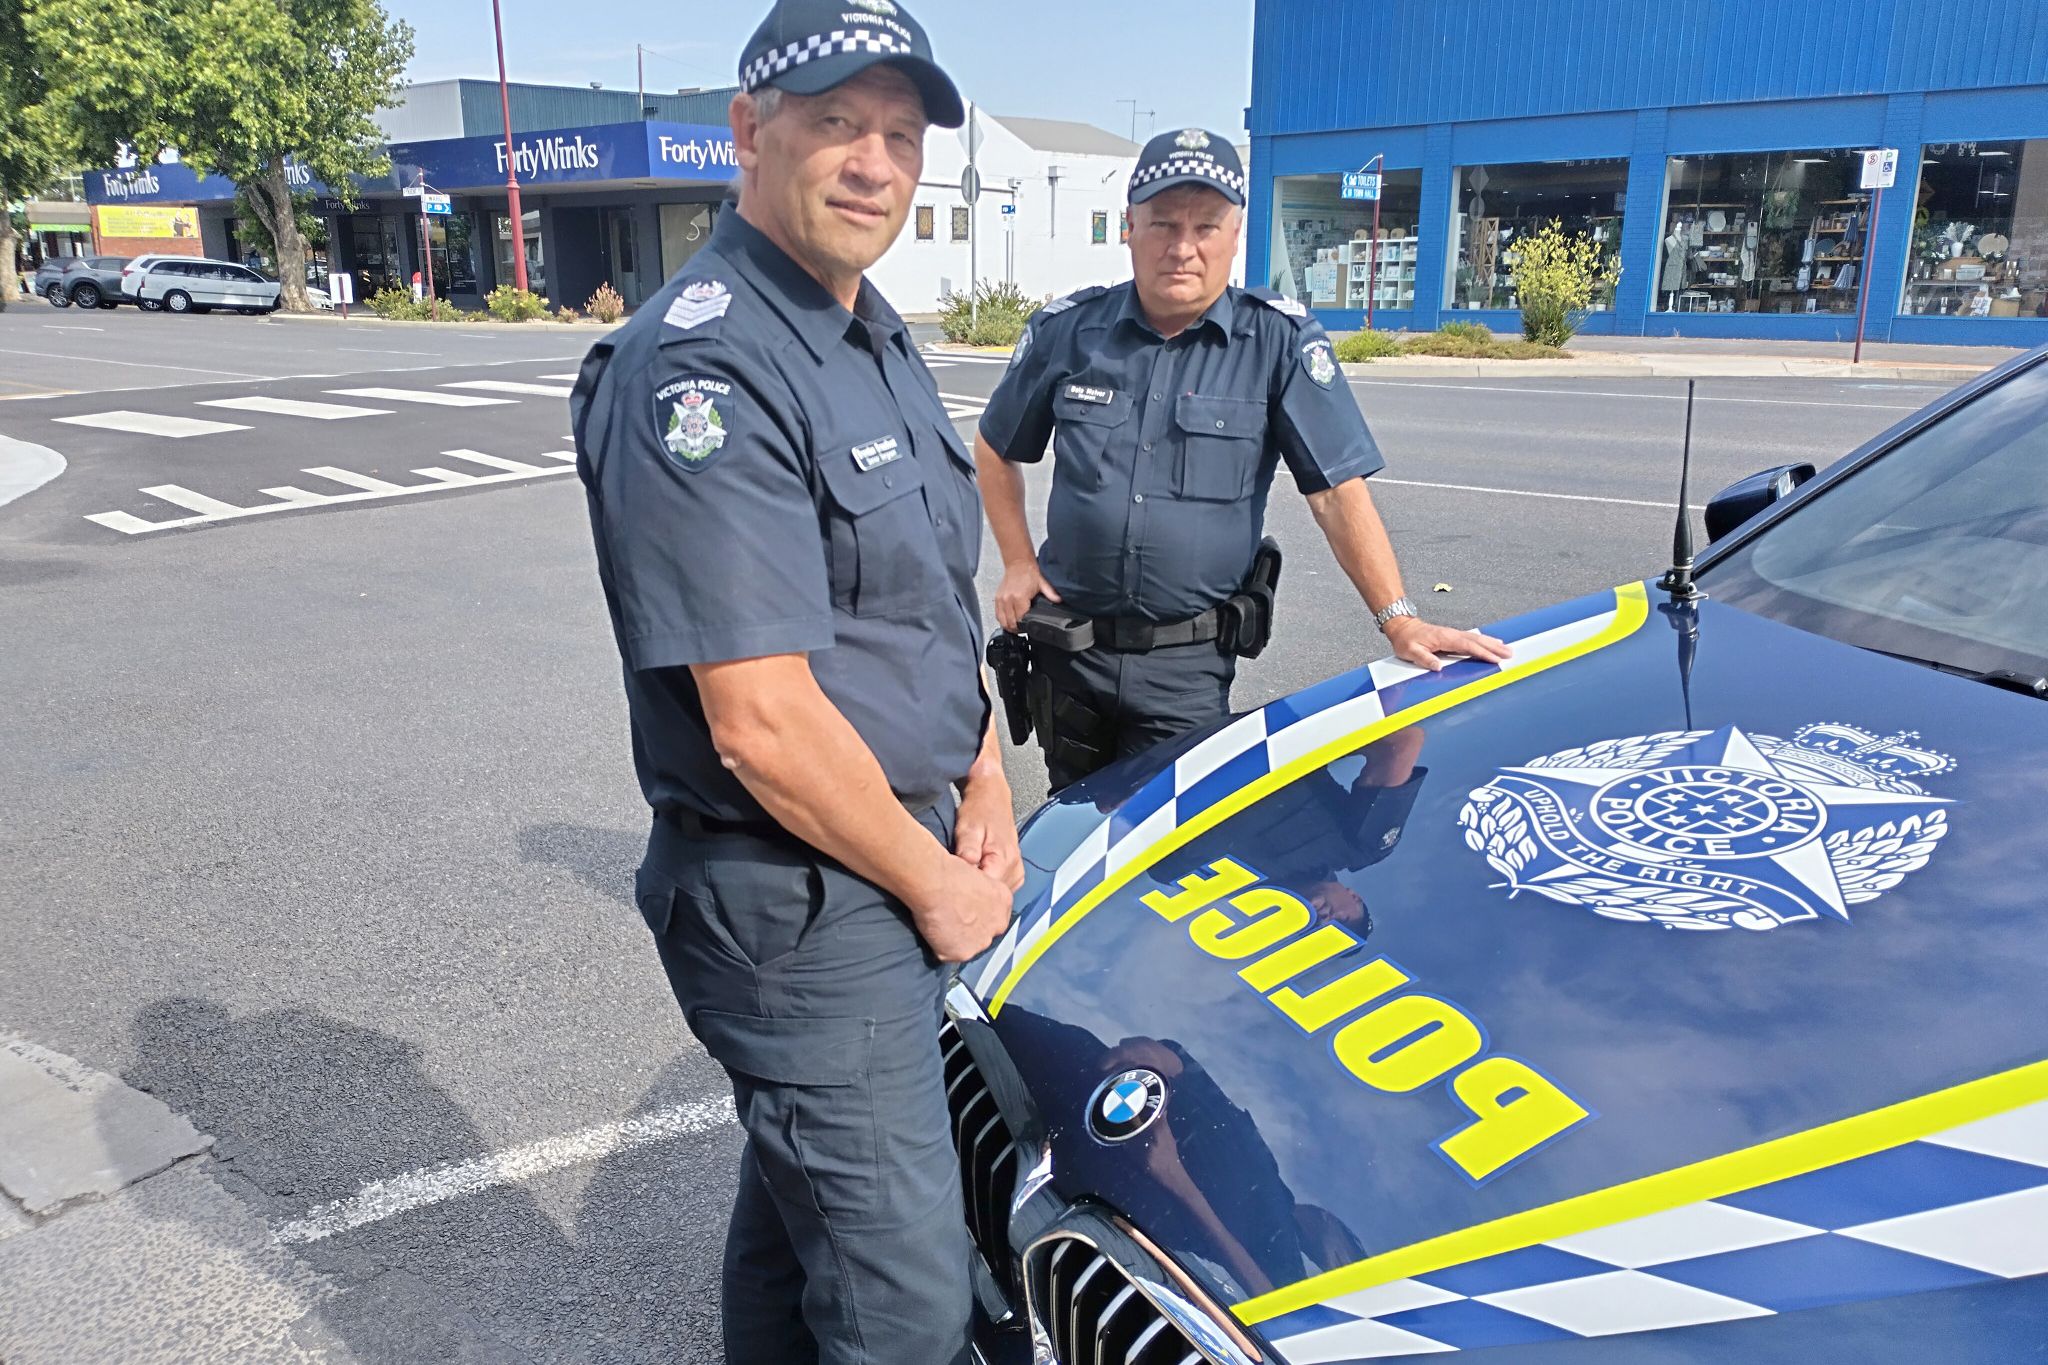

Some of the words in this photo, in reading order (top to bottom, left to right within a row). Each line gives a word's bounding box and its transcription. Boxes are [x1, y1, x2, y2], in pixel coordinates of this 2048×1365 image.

[841, 12, 884, 27] VICTORIA
[1357, 173, 1376, 187] TOILETS
[656, 379, 697, 401] VICTORIA
[697, 379, 731, 396] POLICE
[1646, 768, 1817, 834] VICTORIA
[1523, 788, 1571, 841] UPHOLD
[1566, 843, 1626, 872] THE
[1637, 865, 1759, 896] RIGHT
[1600, 797, 1736, 856] POLICE
[1138, 857, 1590, 1182] POLICE
[1124, 1071, 1161, 1110] BMW
